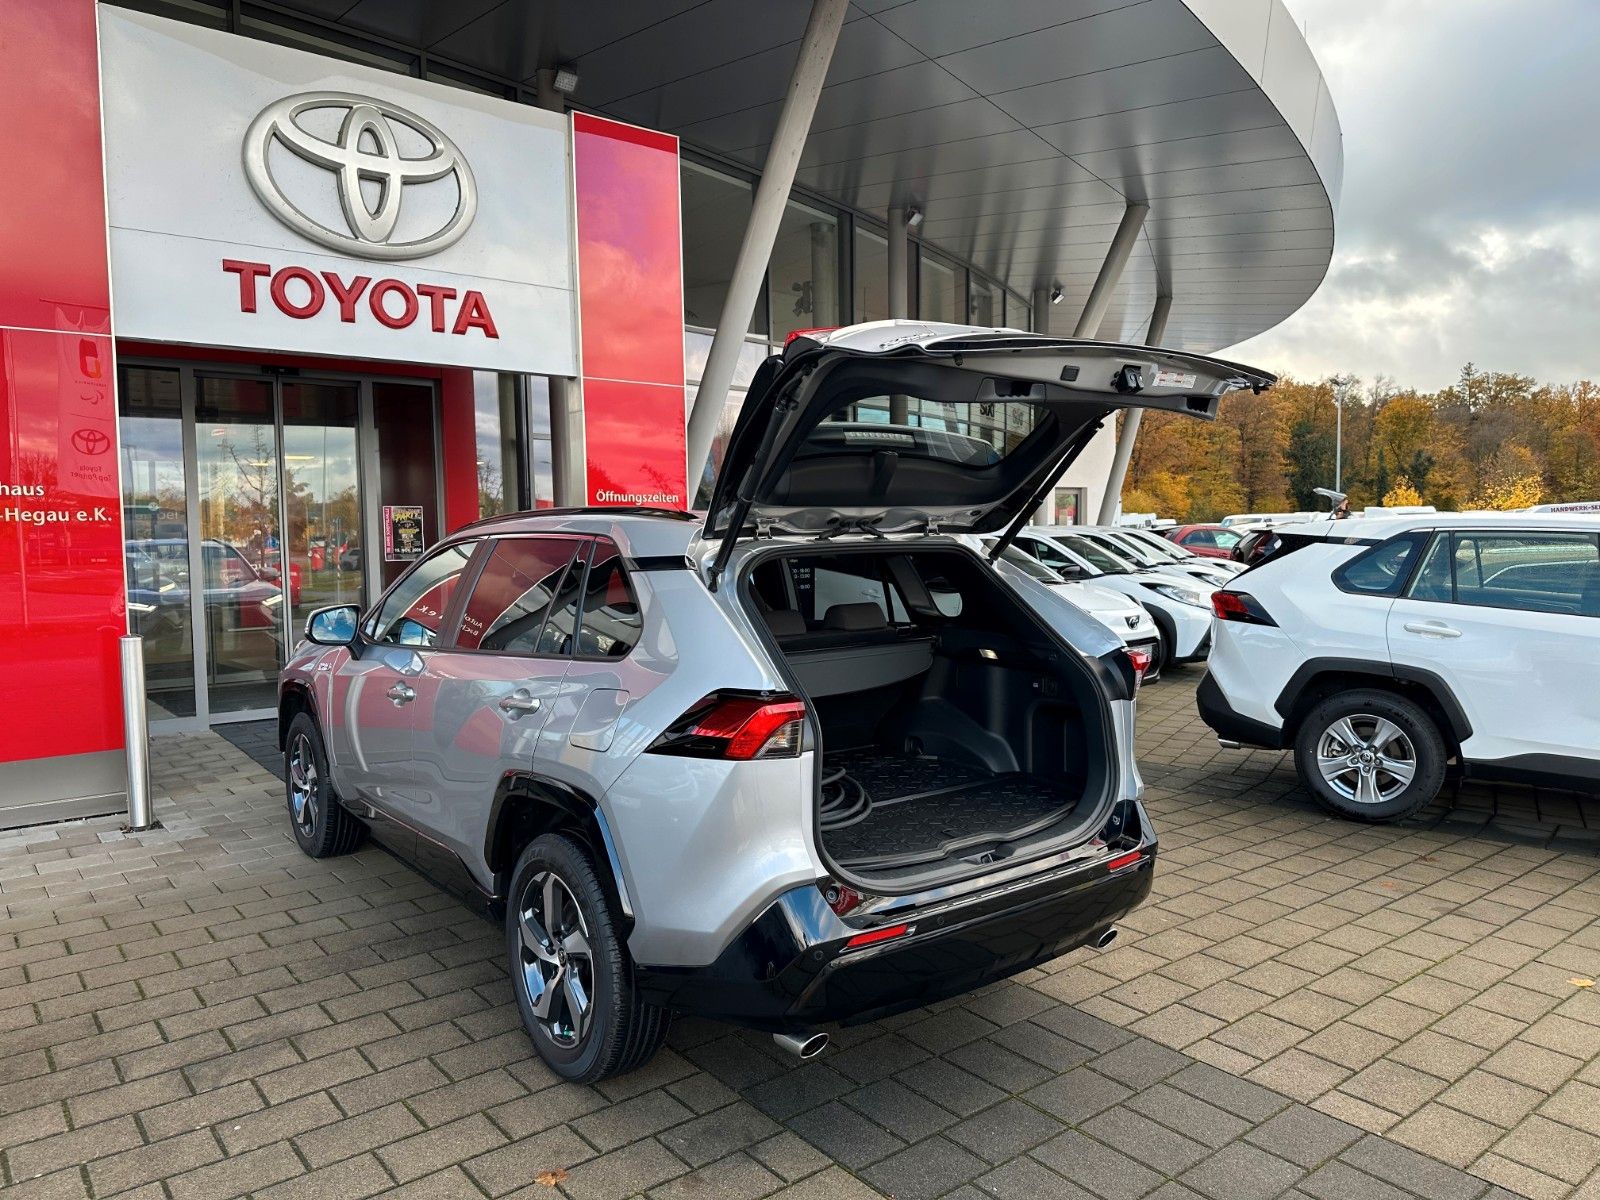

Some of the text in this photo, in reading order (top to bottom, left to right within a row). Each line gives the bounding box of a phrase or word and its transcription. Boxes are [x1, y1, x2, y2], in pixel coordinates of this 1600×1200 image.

[222, 258, 499, 339] TOYOTA
[0, 482, 45, 496] haus
[595, 488, 679, 506] Öffnungszeiten
[76, 508, 112, 522] e.K.
